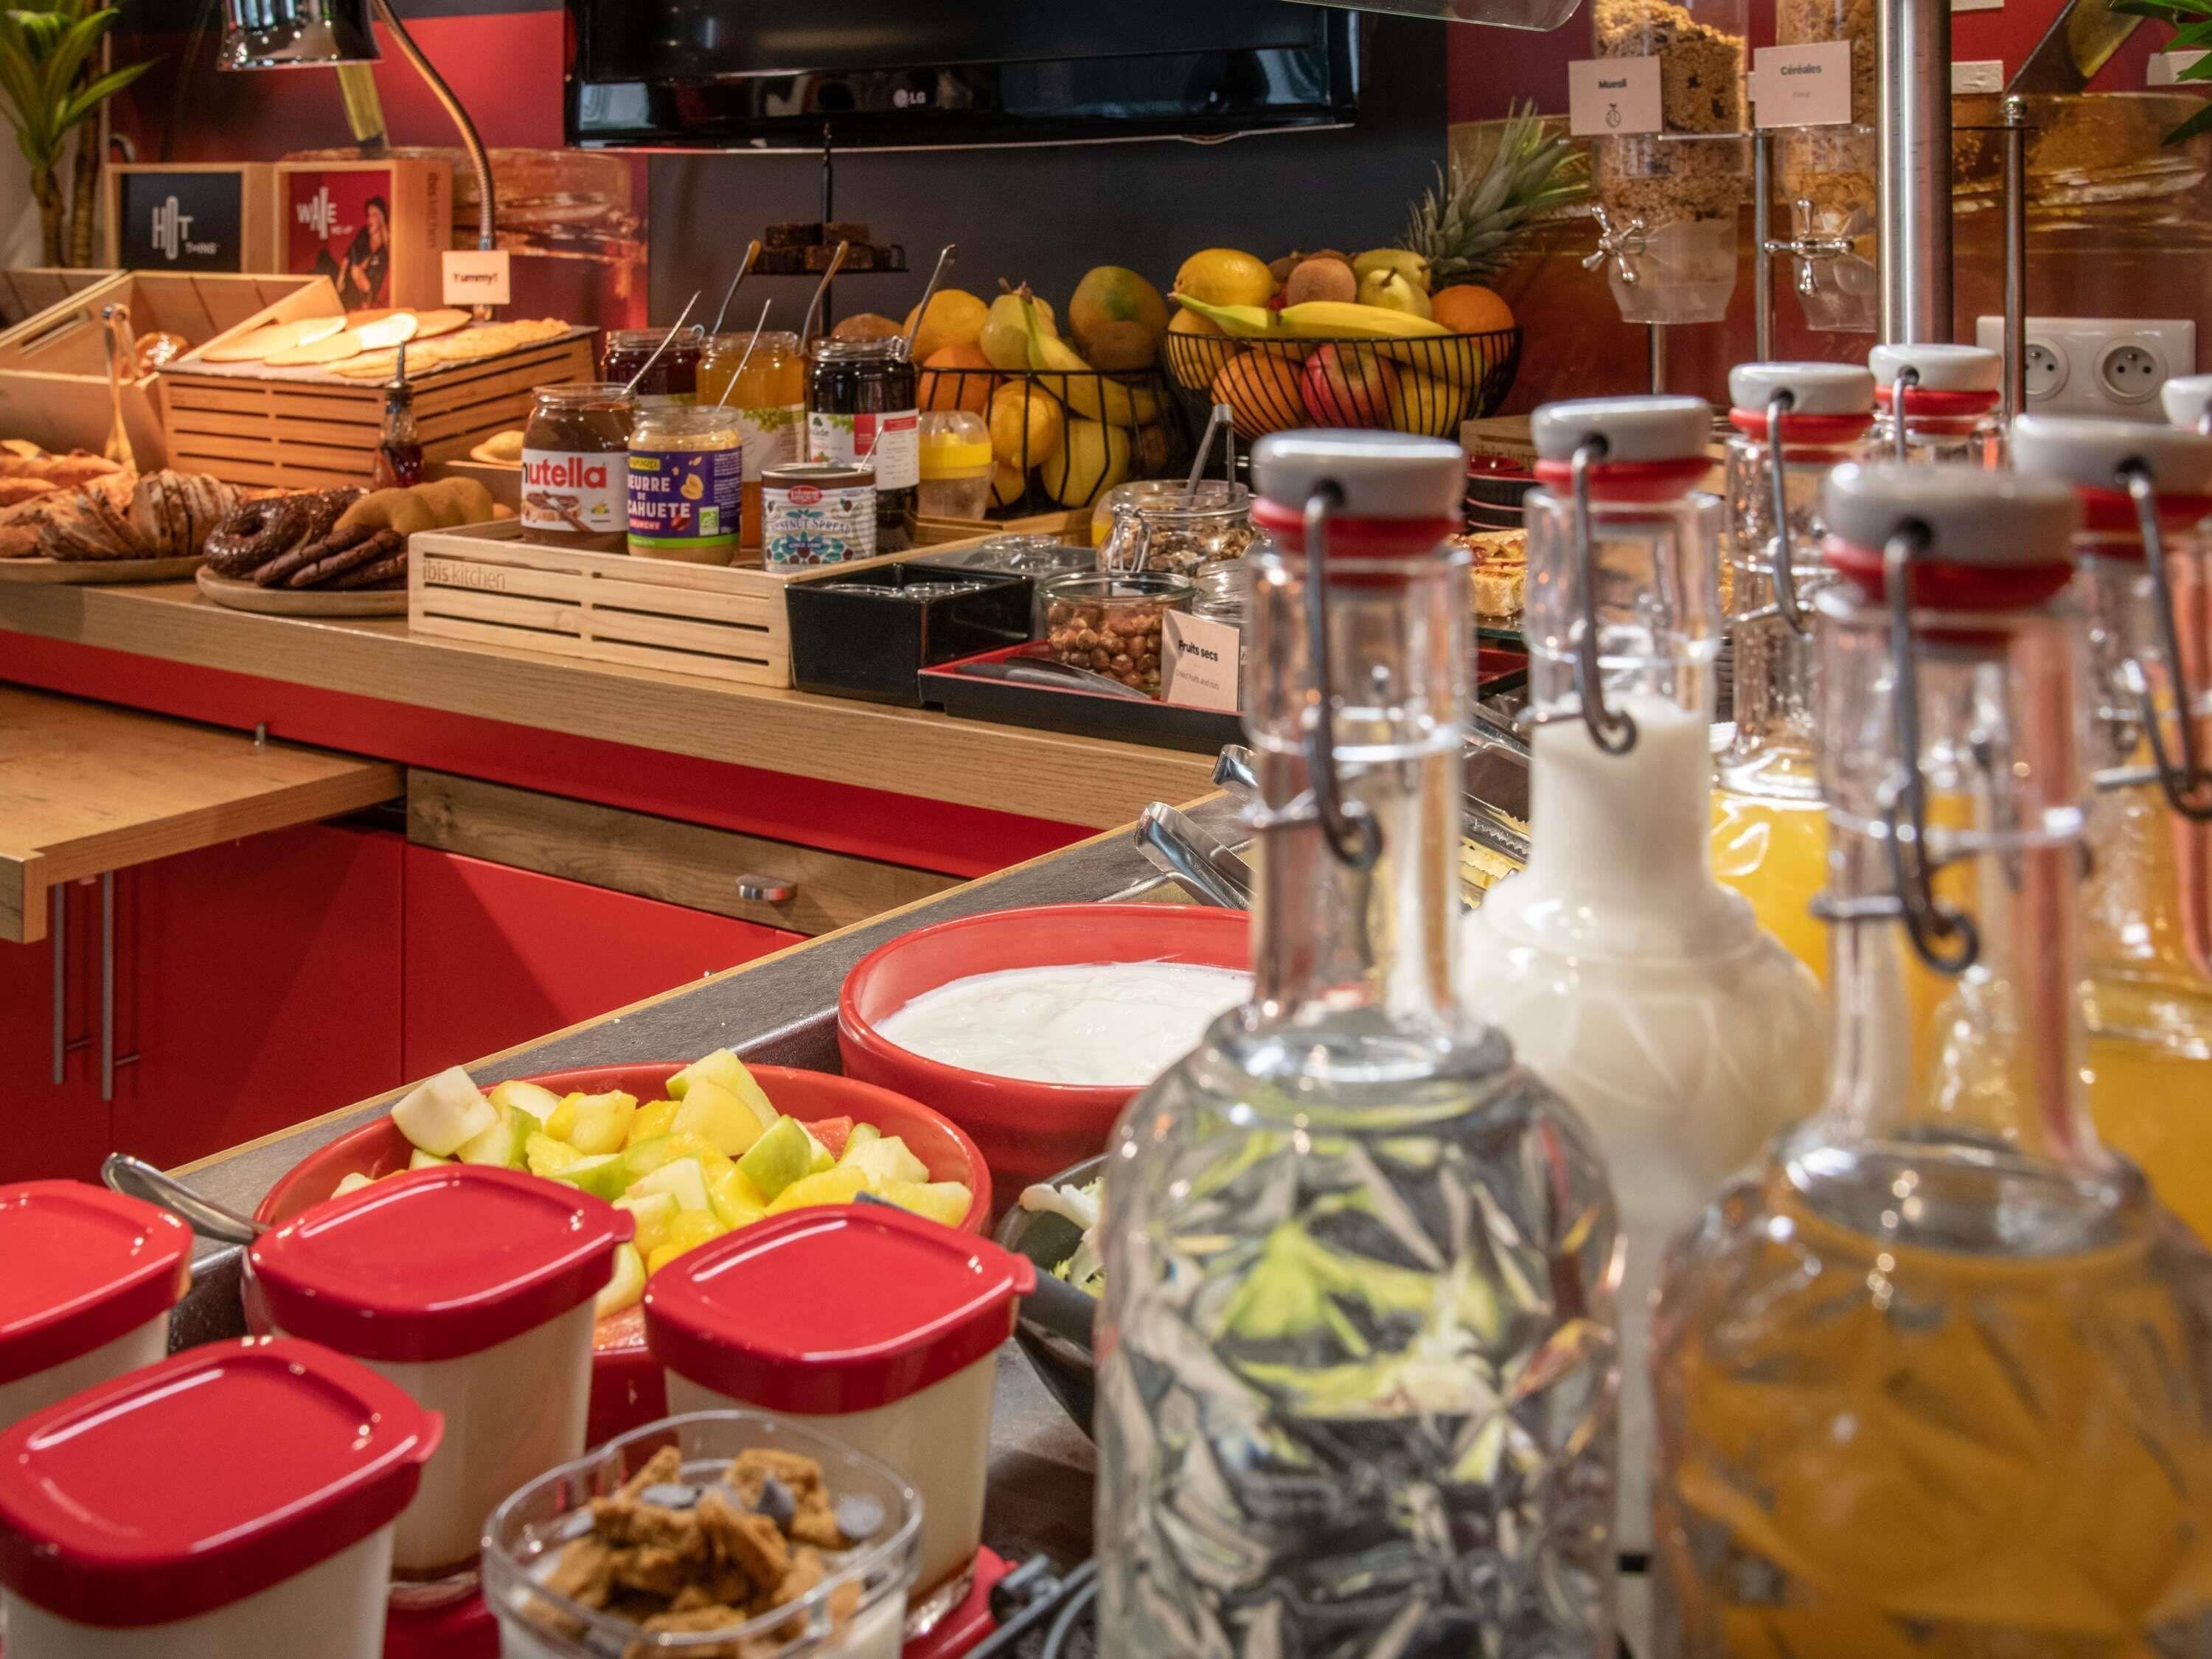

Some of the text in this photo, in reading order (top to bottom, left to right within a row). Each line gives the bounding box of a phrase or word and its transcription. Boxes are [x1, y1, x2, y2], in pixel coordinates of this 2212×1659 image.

[1781, 63, 1822, 75] Céréales
[909, 91, 927, 105] LG
[152, 195, 194, 260] HOT
[423, 560, 506, 590] ibis kitchen
[1178, 639, 1218, 661] Fruits secs
